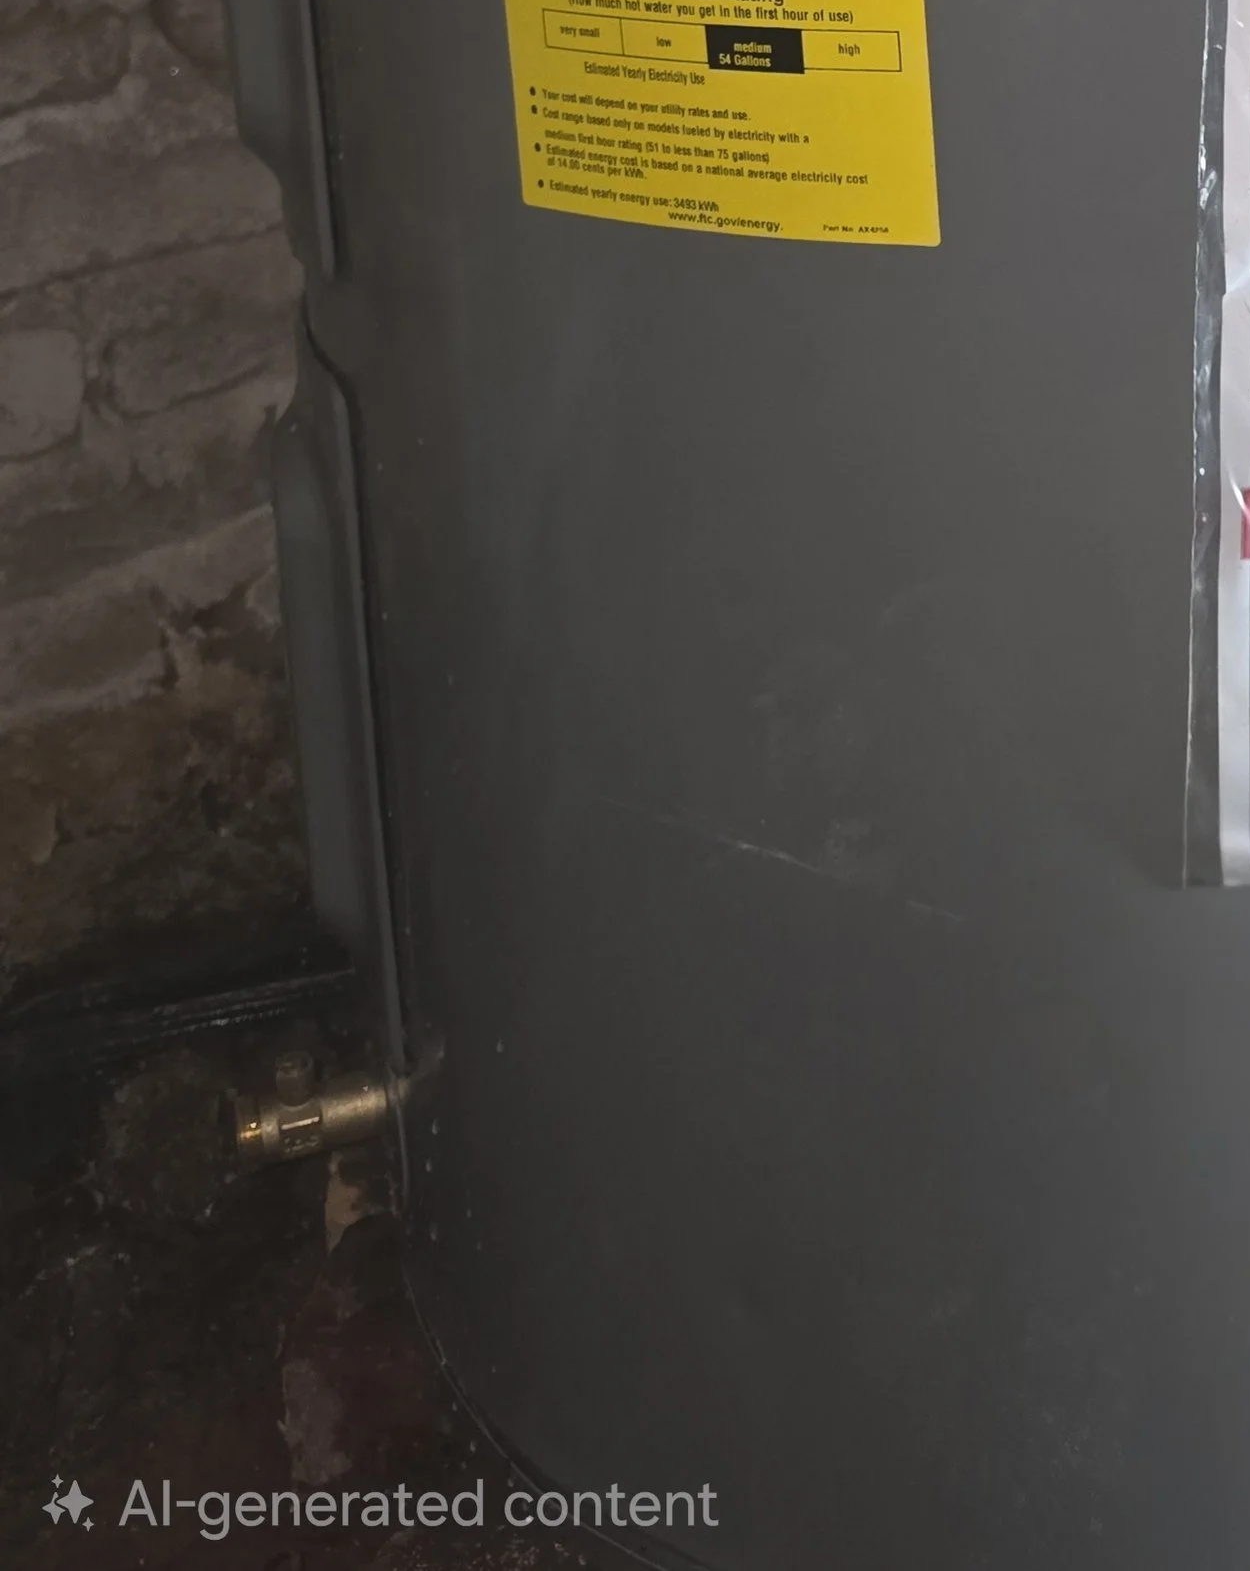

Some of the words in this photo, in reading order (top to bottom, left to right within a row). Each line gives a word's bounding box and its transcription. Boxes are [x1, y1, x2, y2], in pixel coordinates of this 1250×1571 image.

[644, 1, 672, 13] water
[676, 4, 695, 17] you
[700, 5, 715, 18] get
[720, 5, 730, 17] in
[734, 6, 752, 19] the
[756, 7, 779, 20] first
[782, 9, 808, 21] hour
[813, 10, 824, 22] of
[829, 11, 853, 24] use)
[560, 26, 576, 37] very
[656, 36, 671, 47] low
[734, 42, 772, 54] medium
[838, 43, 860, 55] high
[719, 54, 731, 65] 54
[734, 54, 771, 67] Gallons
[584, 62, 620, 78] Estimated
[623, 65, 647, 82] Yearly
[649, 68, 688, 86] Electricity
[690, 73, 705, 85] Use
[542, 88, 560, 101] Your
[562, 92, 577, 103] cost
[579, 95, 593, 105] will
[595, 96, 625, 110] depend
[627, 101, 637, 110] on
[640, 103, 658, 113] your
[688, 108, 710, 118] rates
[712, 109, 728, 119] and
[732, 111, 751, 121] use.
[543, 107, 560, 119] Cost
[562, 111, 584, 124] range
[587, 113, 611, 127] based
[613, 117, 631, 130] only
[634, 121, 644, 130] on
[648, 121, 680, 134] models
[682, 125, 710, 137] fueled
[714, 127, 725, 140] by
[728, 130, 775, 144] electricity
[778, 134, 800, 143] with
[578, 133, 594, 145] first
[596, 136, 615, 147] hour
[618, 138, 642, 152] rating
[662, 144, 671, 153] to
[673, 145, 692, 156] less
[694, 147, 714, 158] than
[717, 149, 729, 160] 75
[732, 151, 769, 164] gallons)
[546, 143, 586, 160] Estimated
[588, 150, 617, 166] energy
[620, 154, 639, 166] cost
[641, 156, 649, 168] is
[651, 157, 678, 172] based
[682, 164, 693, 173] on
[697, 165, 702, 174] a
[705, 165, 744, 177] national
[748, 170, 788, 182] average
[791, 171, 842, 185] electricity
[846, 175, 868, 184] cost
[550, 180, 589, 195] Estimated
[591, 187, 617, 200] yearly
[619, 191, 650, 205] energy
[653, 196, 672, 207] use:
